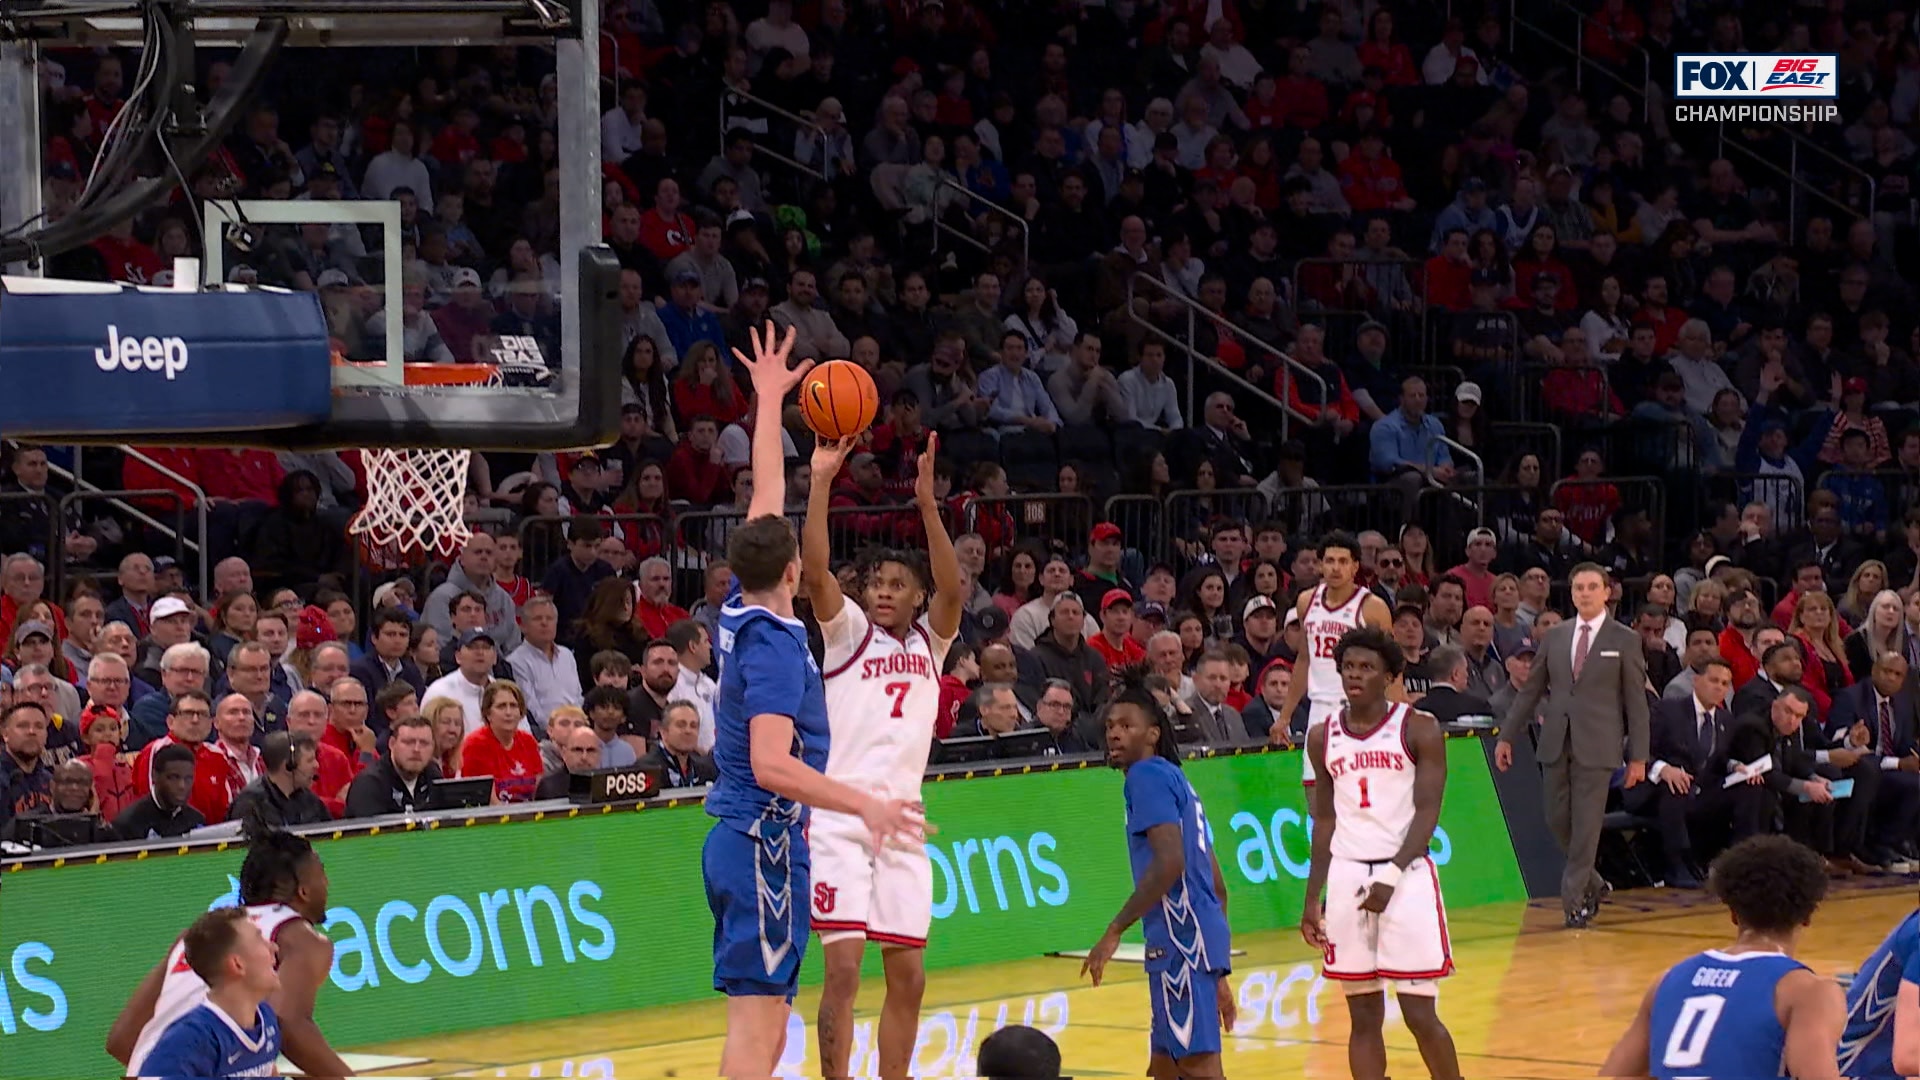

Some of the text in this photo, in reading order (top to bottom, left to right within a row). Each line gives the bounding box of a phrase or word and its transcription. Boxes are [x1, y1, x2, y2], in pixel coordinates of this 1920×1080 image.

[95, 324, 188, 380] Jeep
[1314, 635, 1337, 658] 18
[885, 682, 911, 718] 7
[606, 772, 646, 796] POSS
[1358, 777, 1371, 809] 1
[923, 832, 1069, 919] orns
[323, 880, 615, 992] acorns
[1692, 966, 1741, 988] GREEN
[1663, 994, 1727, 1069] 0
